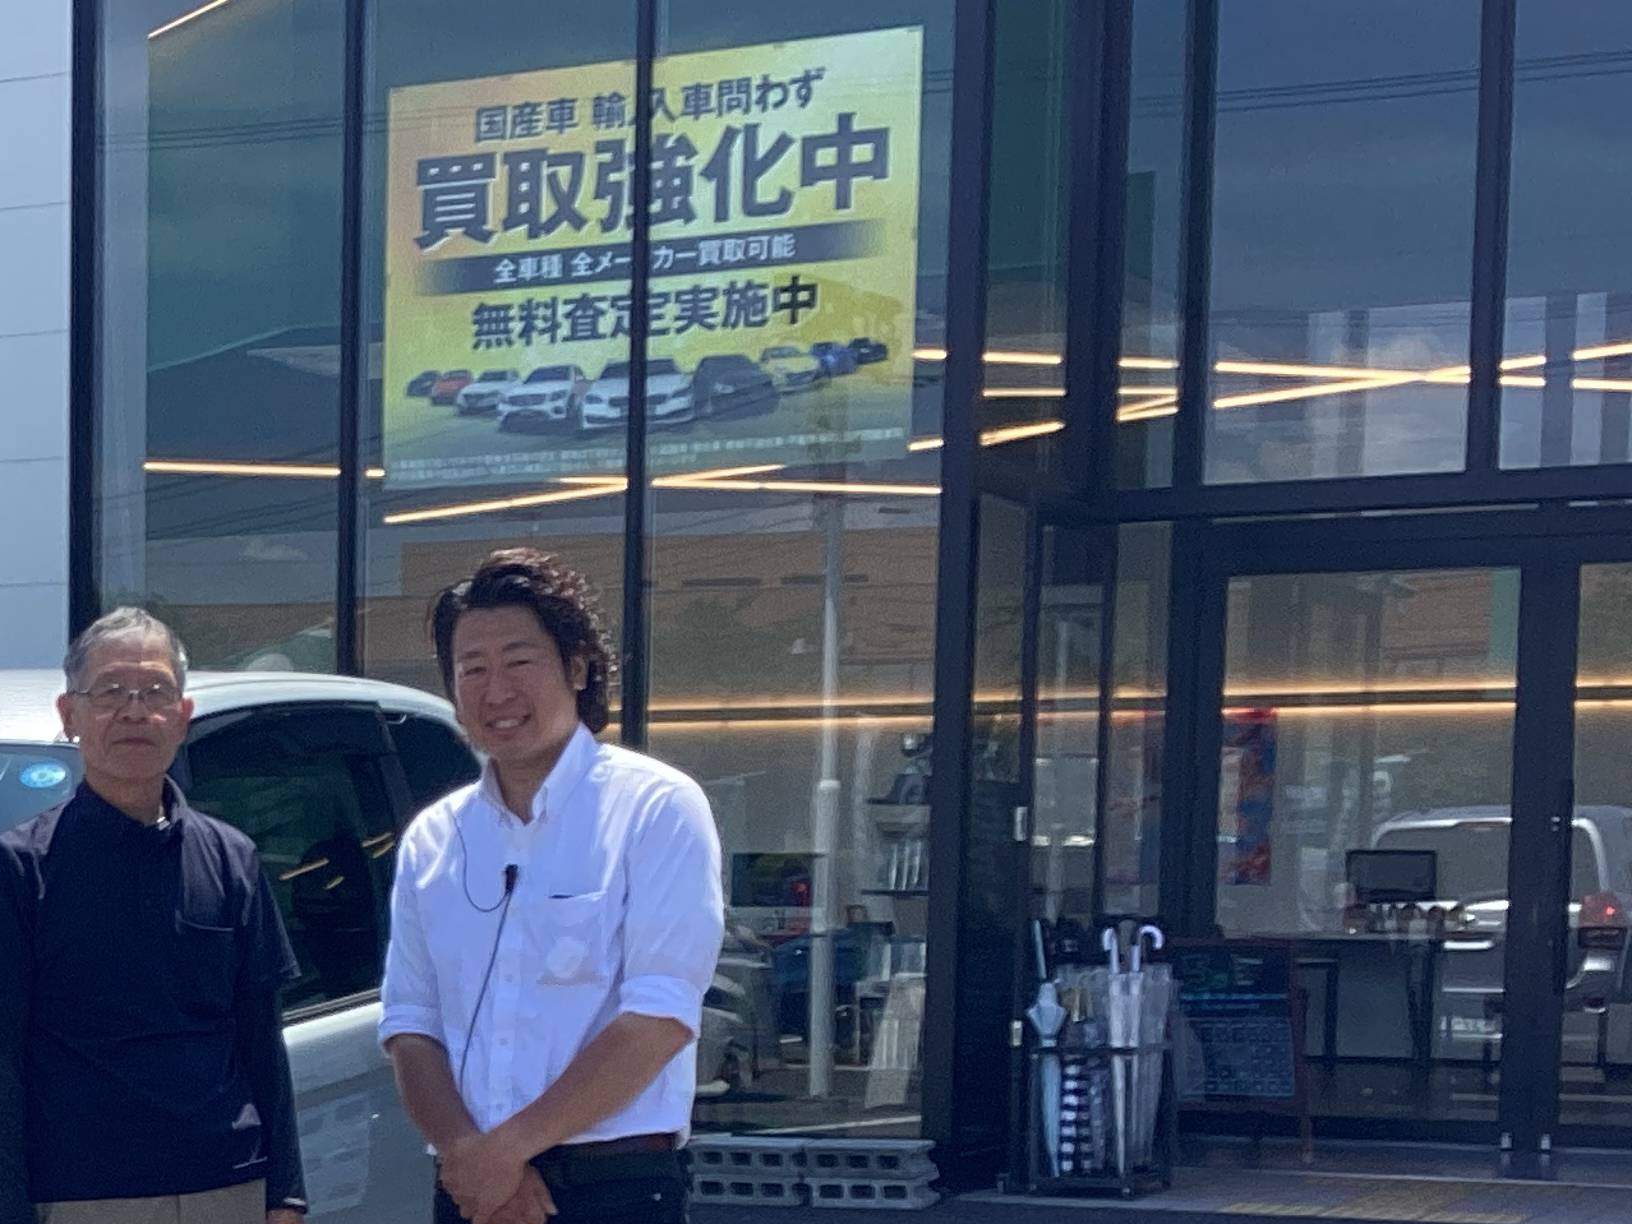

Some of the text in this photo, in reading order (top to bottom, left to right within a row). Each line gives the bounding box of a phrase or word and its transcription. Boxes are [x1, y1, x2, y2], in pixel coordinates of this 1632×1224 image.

[474, 66, 827, 144] 国産車 輸入車問わず
[414, 112, 891, 250] 買取強化中
[494, 233, 796, 284] 全車種 全メーカー買取可能
[471, 274, 818, 350] 無料査定実施中
